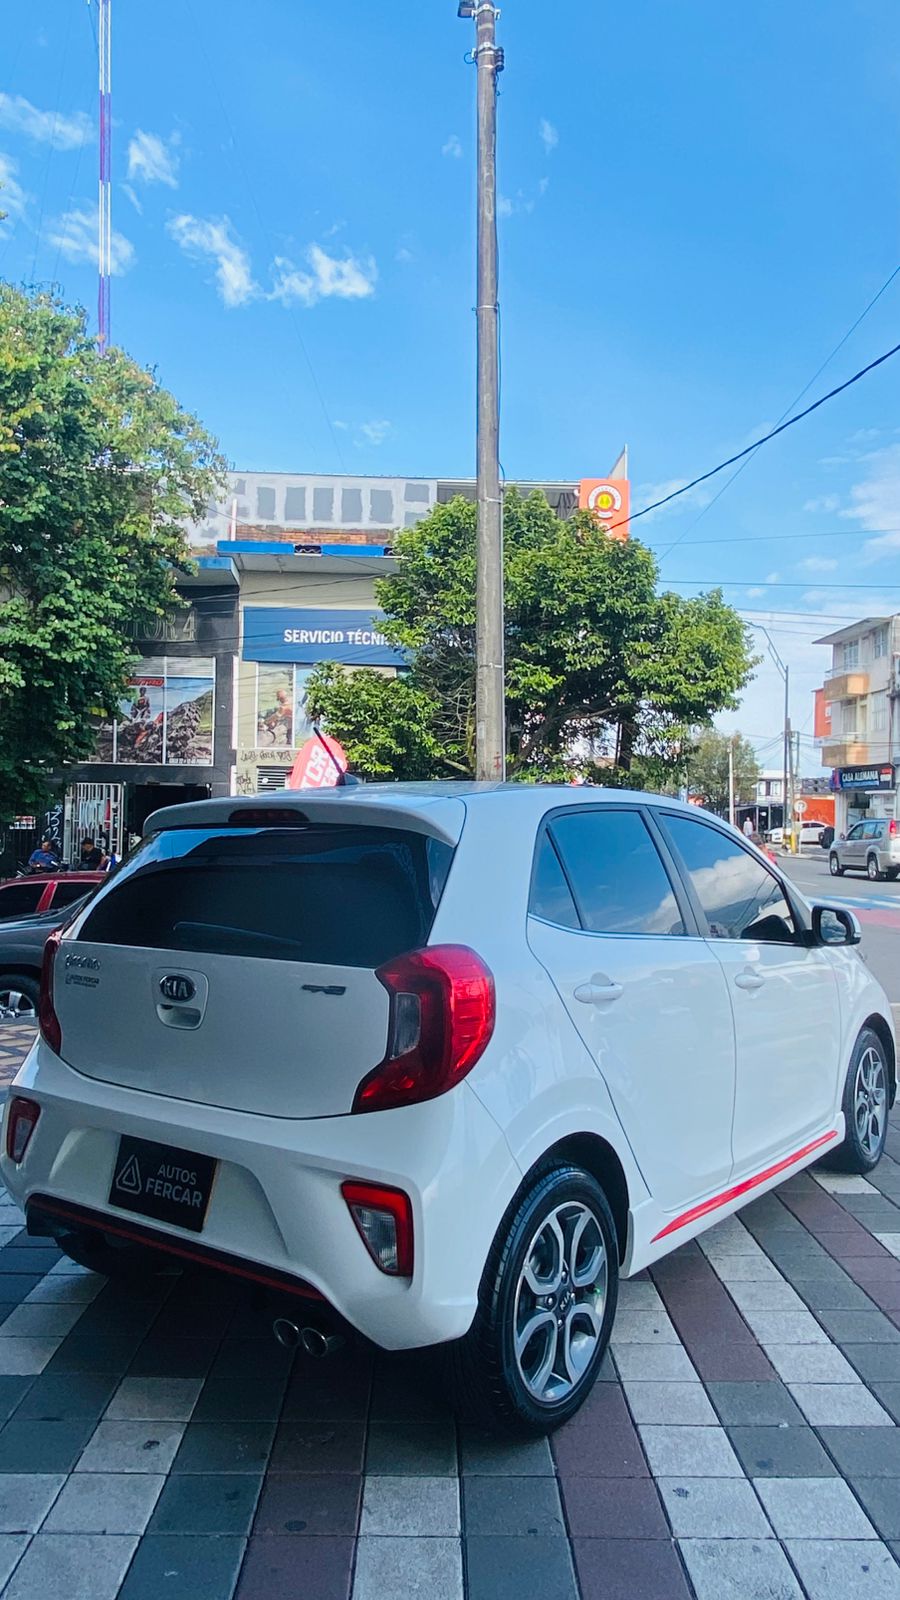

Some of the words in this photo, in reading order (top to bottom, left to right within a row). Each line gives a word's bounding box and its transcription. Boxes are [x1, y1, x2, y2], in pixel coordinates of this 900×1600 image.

[182, 610, 197, 641] 4
[283, 629, 344, 643] SERVICIO
[346, 629, 402, 646] TÉCNI
[164, 980, 188, 998] KIA
[157, 1163, 197, 1186] AUTOS
[145, 1177, 203, 1209] FERCAR
